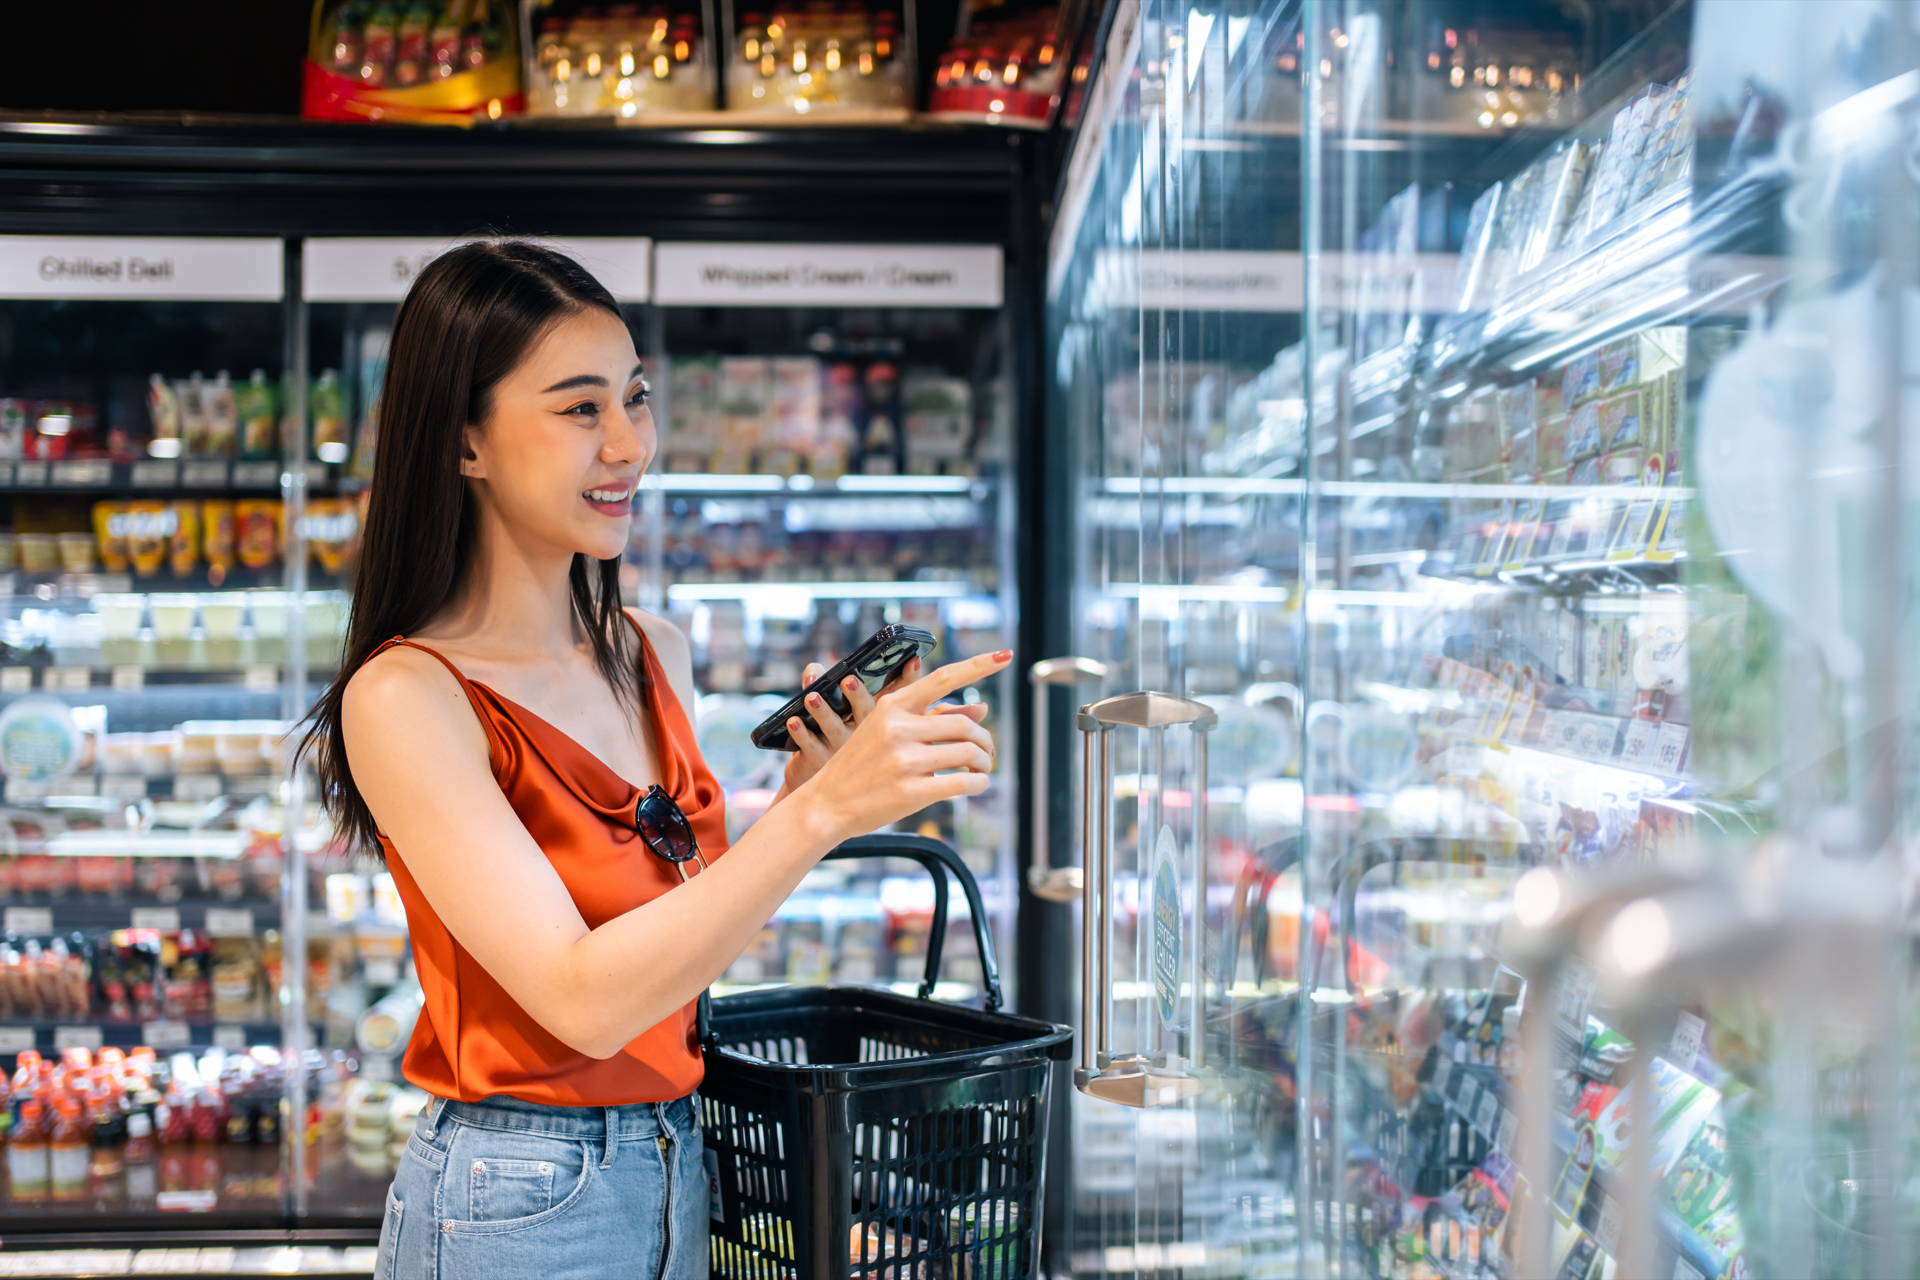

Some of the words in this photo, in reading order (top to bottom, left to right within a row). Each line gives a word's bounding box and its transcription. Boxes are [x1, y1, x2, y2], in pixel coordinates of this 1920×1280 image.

[38, 256, 122, 281] Chilled
[128, 256, 174, 281] Deli
[700, 263, 796, 291] Whipped
[1157, 893, 1177, 933] ENERGY
[1157, 919, 1175, 952] EFFICIENT
[1156, 940, 1176, 983] CHILLER
